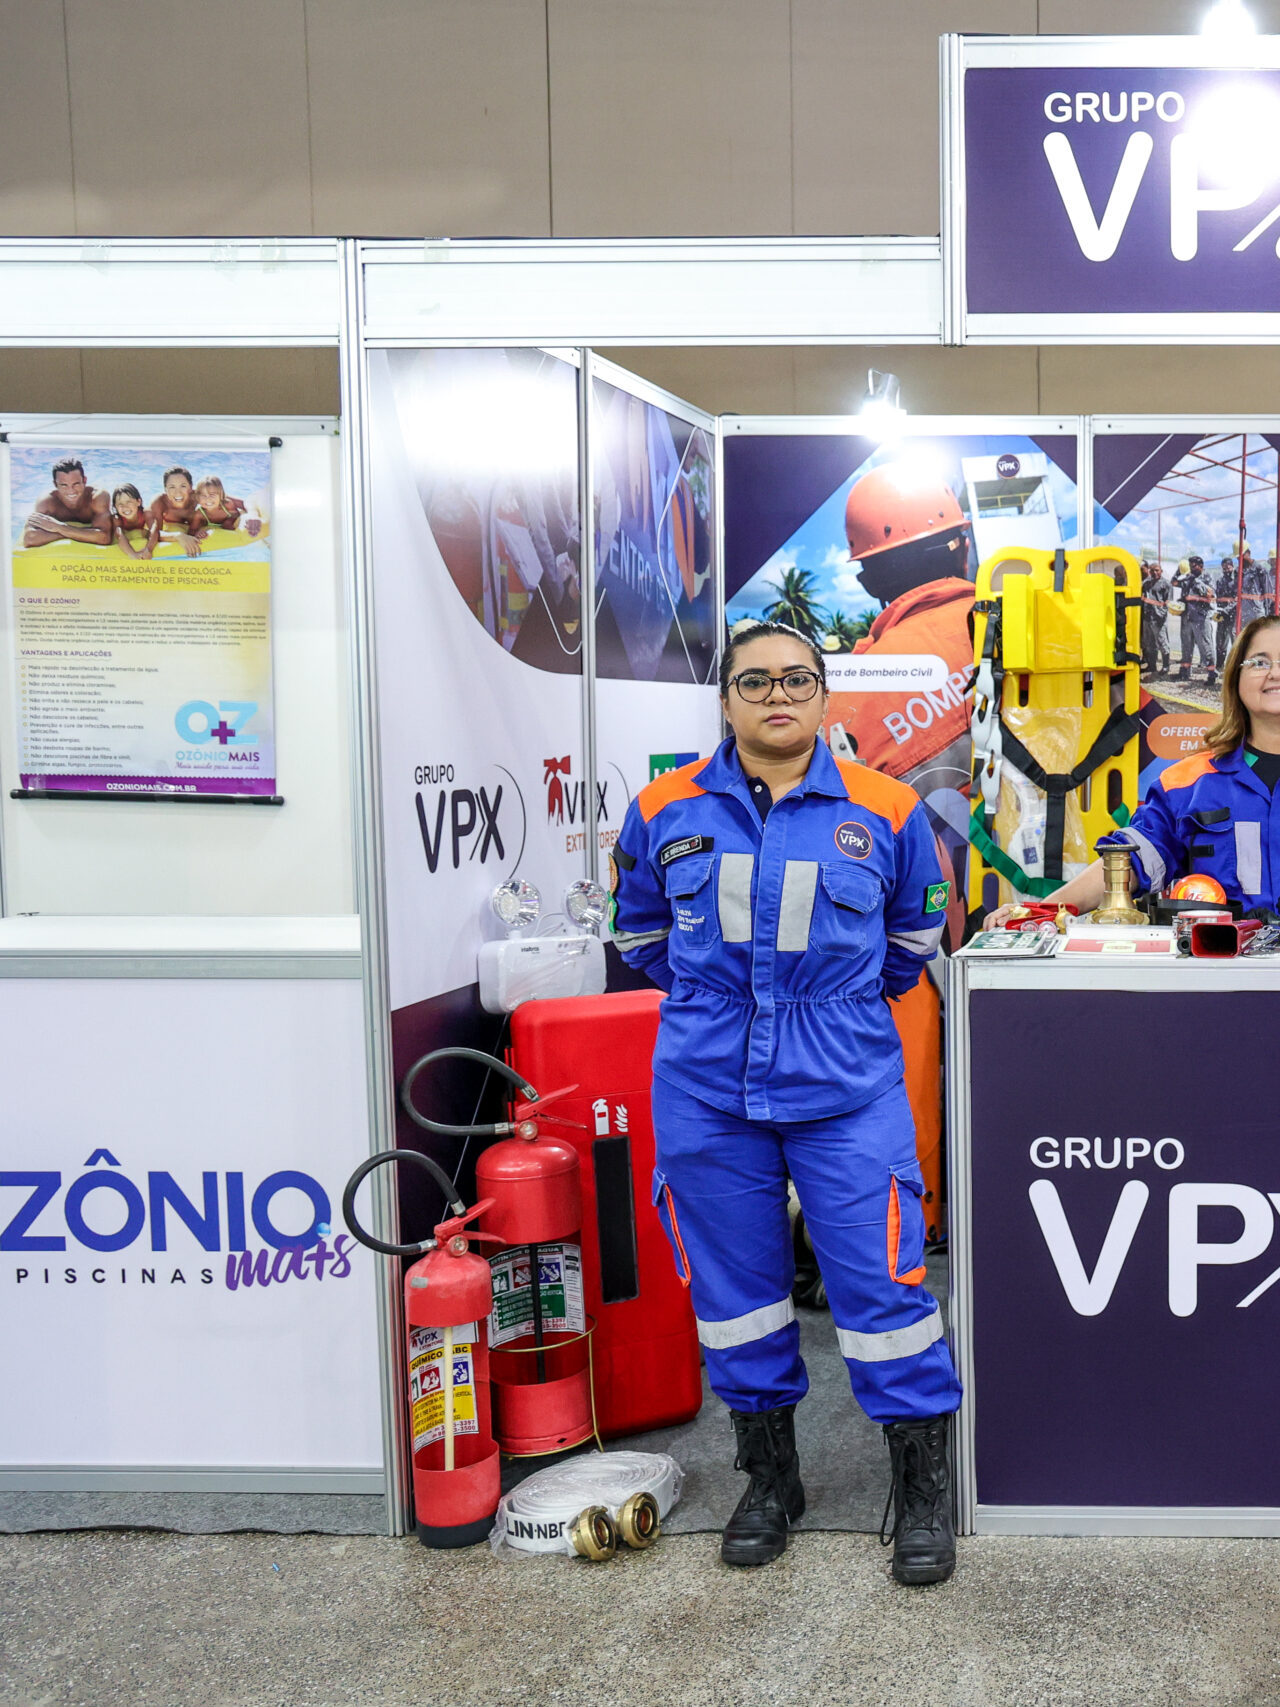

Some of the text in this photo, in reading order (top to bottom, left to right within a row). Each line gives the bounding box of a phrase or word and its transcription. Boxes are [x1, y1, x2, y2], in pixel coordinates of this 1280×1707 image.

[1044, 91, 1185, 123] GRUPO
[999, 462, 1015, 471] VPX
[61, 564, 92, 573] OPÇÃO
[120, 565, 166, 574] SAUDÁVEL
[179, 566, 231, 575] ECOLÓGICA
[100, 576, 160, 584] TRATAMENTO
[844, 669, 857, 677] de
[860, 669, 908, 677] Bombeiro
[911, 669, 932, 677] Civil
[1160, 726, 1209, 737] OFEREC
[1180, 741, 1198, 750] EM
[415, 764, 454, 785] GRUPO
[415, 785, 504, 873] VPX
[566, 830, 619, 853] EXTITORES
[840, 833, 864, 849] VPX
[1029, 1136, 1185, 1169] GRUPO
[16, 1268, 214, 1284] PISCINAS
[418, 1331, 438, 1345] VPX
[419, 1338, 445, 1351] EXTINTORE
[411, 1346, 468, 1370] QUÍMICO BC
